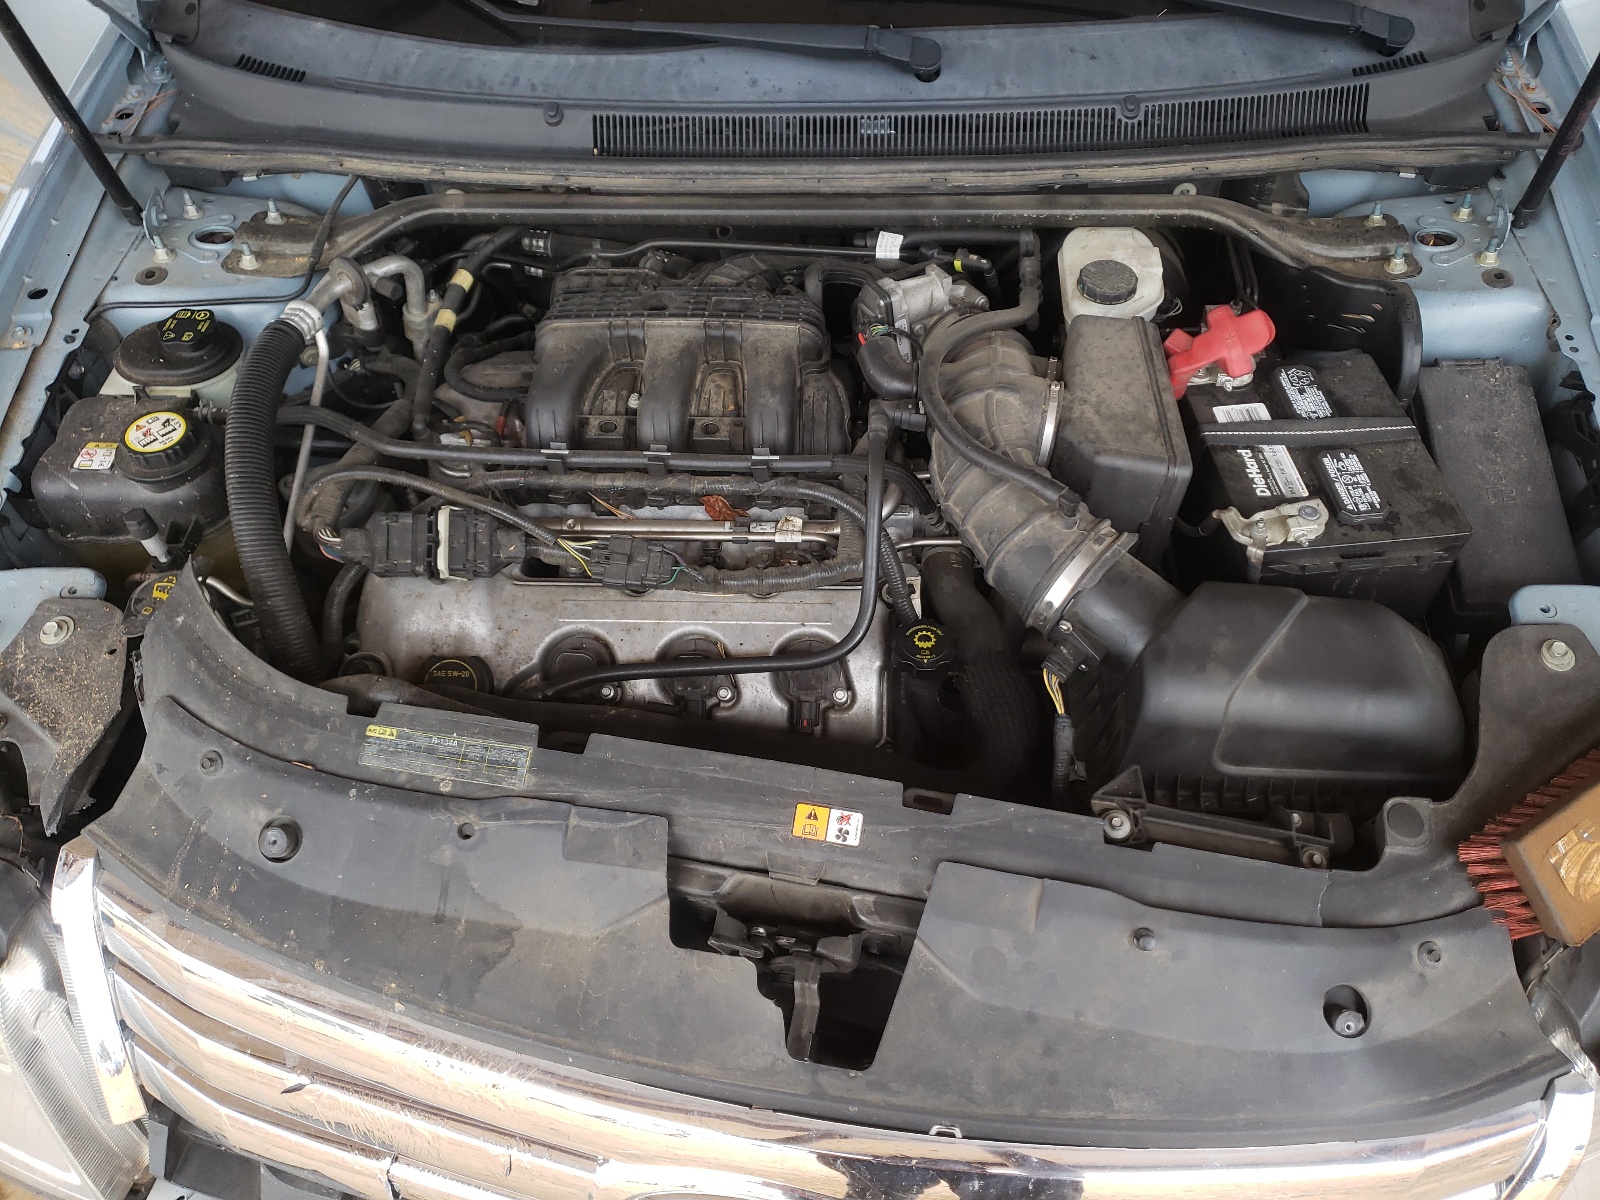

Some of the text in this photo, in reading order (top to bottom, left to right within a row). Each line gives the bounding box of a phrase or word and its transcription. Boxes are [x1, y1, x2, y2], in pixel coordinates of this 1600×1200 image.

[1236, 449, 1272, 497] DieHard
[1321, 457, 1338, 478] POISON
[447, 670, 470, 678] 5W-20
